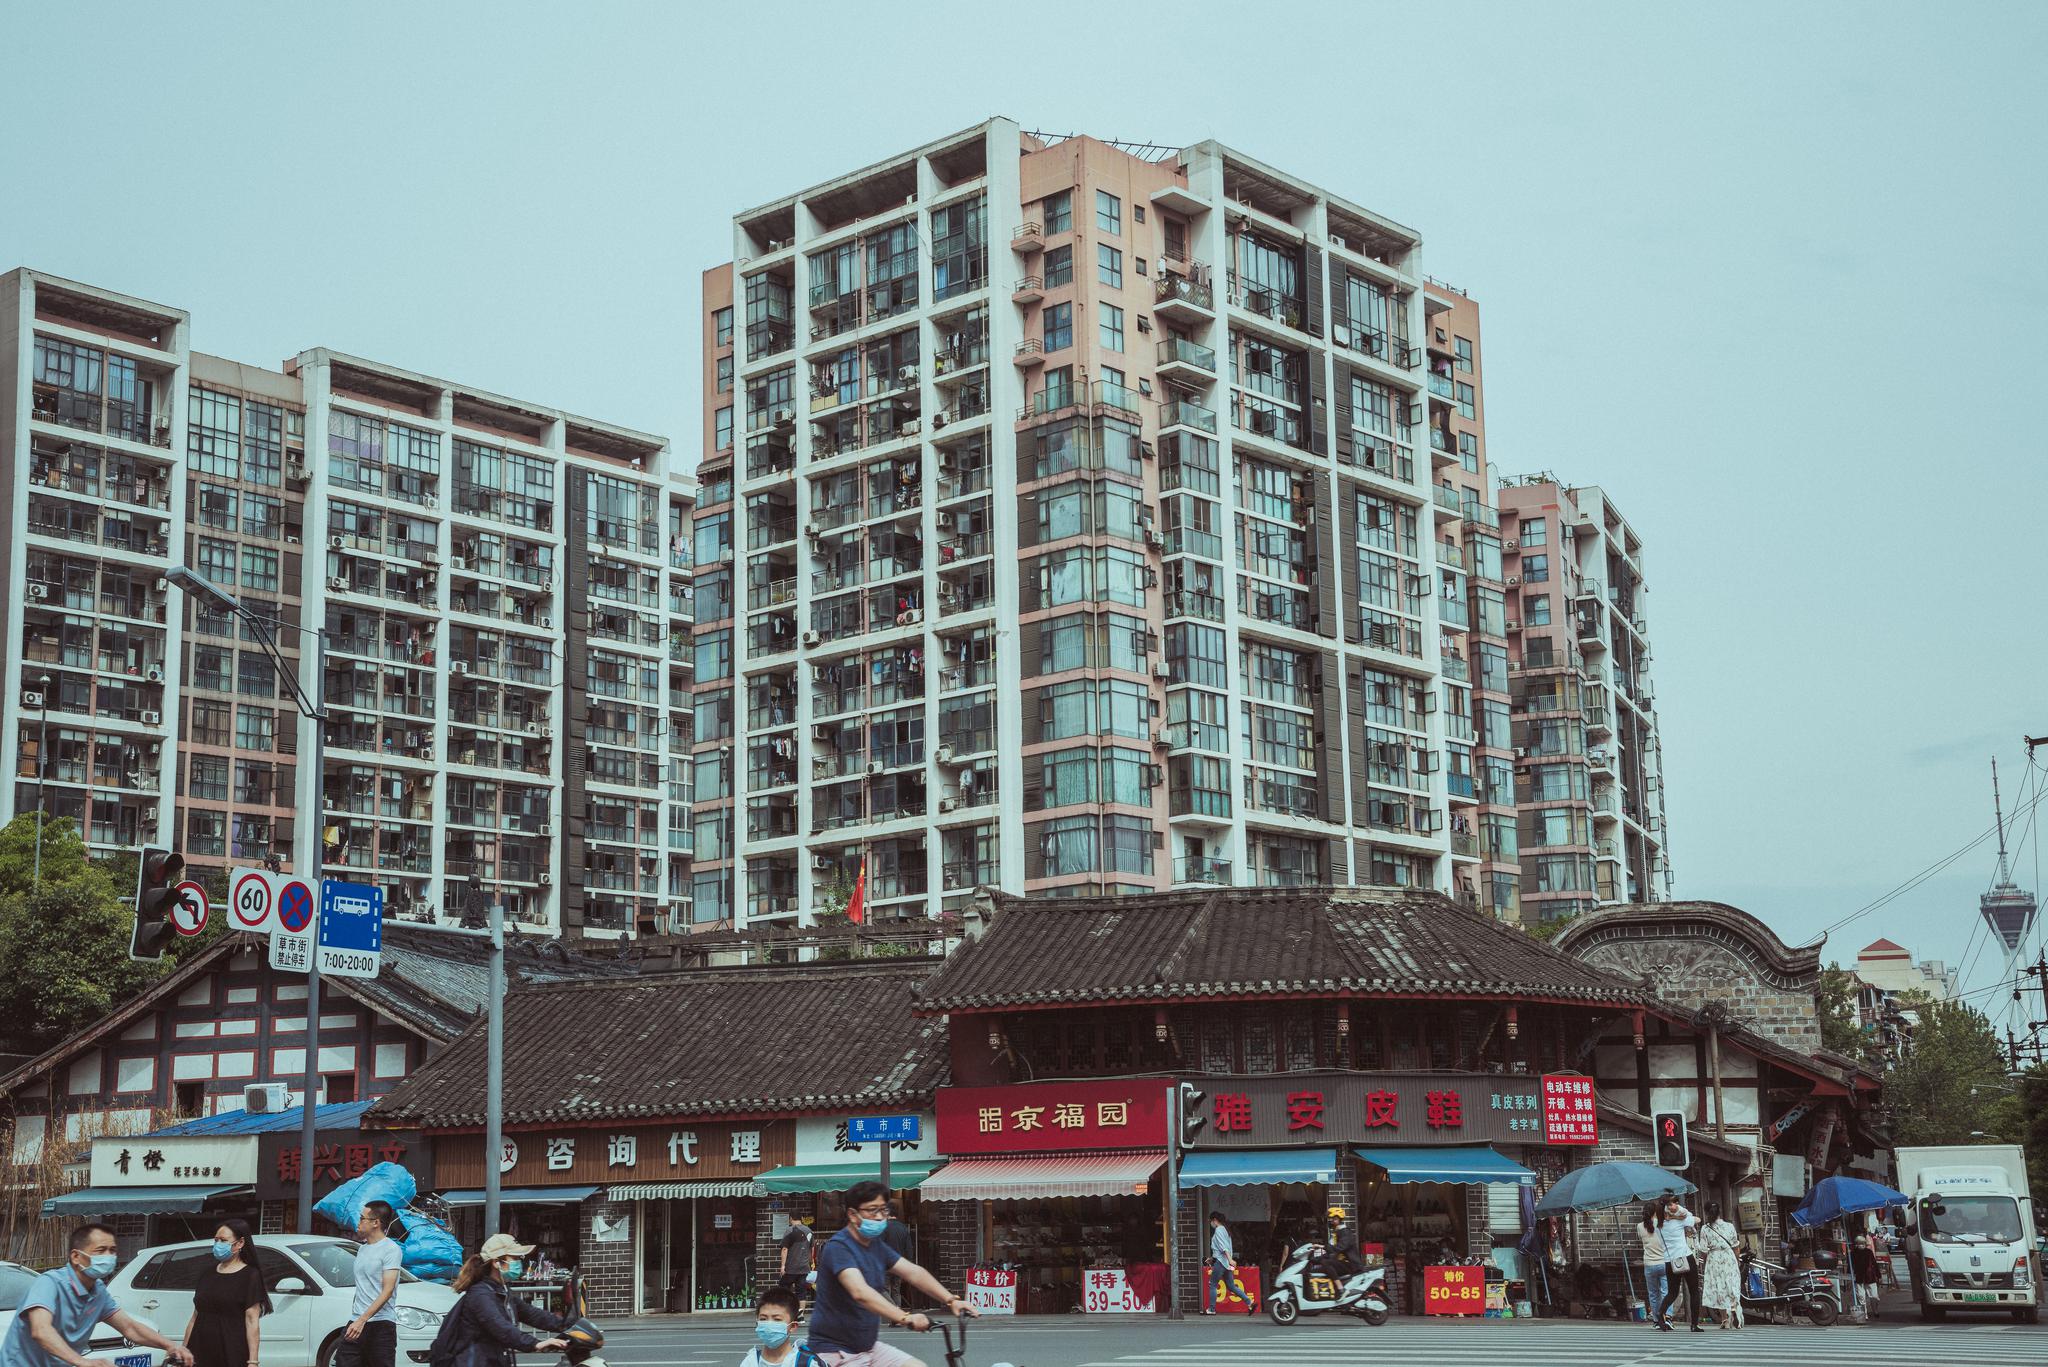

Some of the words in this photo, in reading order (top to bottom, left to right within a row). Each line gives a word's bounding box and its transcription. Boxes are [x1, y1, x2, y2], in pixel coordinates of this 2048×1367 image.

[241, 888, 264, 912] 60
[278, 937, 307, 953] 草市街
[277, 952, 305, 968] 禁止停车
[324, 953, 373, 971] 7:00-20:00
[1546, 1081, 1591, 1094] 电动车维修
[1491, 1094, 1538, 1110] 真皮系列
[1213, 1089, 1464, 1132] 雅安皮鞋
[856, 1118, 912, 1132] 草市街
[546, 1130, 761, 1171] 咨询代理
[114, 1149, 165, 1176] 青橙
[974, 1272, 1010, 1287] 特价
[1444, 1271, 1465, 1282] 特价
[1430, 1287, 1481, 1300] 50-85
